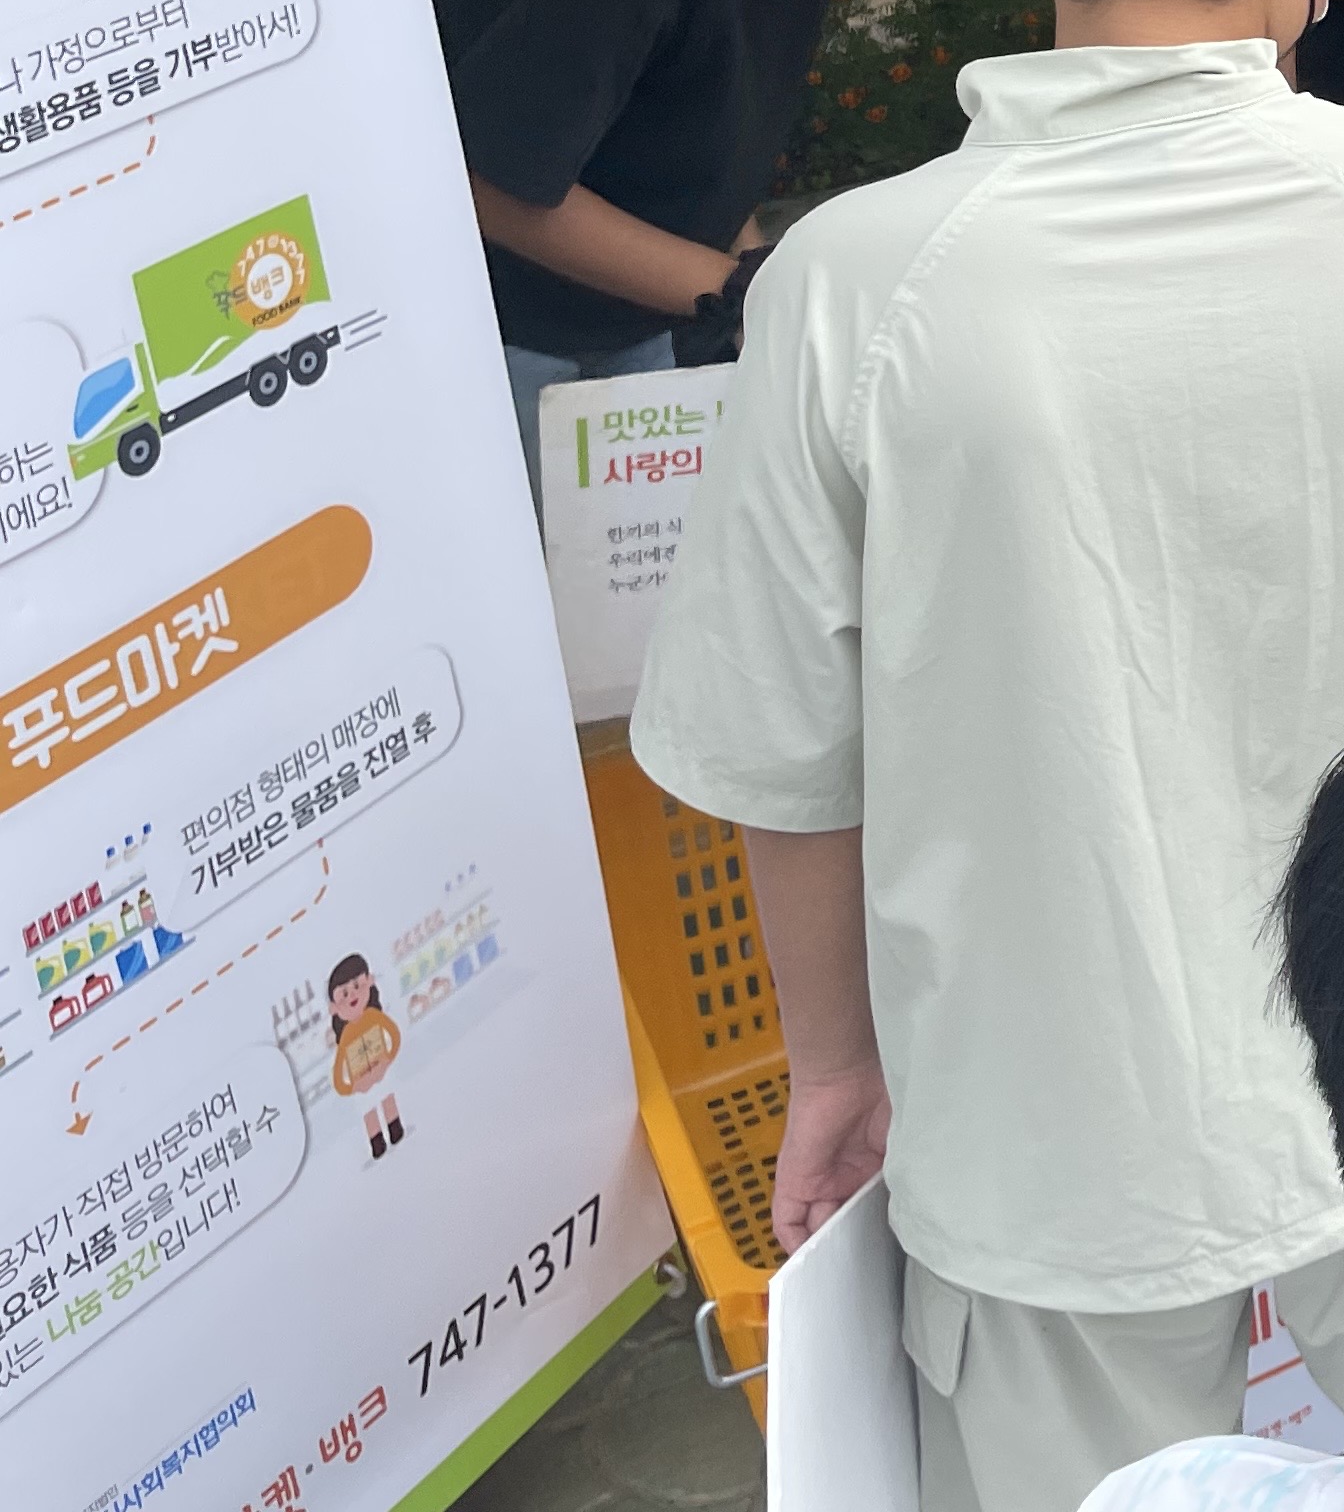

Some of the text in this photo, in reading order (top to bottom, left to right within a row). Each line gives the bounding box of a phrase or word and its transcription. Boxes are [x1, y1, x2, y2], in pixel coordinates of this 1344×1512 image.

[0, 3, 301, 154] 생활용품 등을 기부받아서!
[603, 403, 705, 444] 맛있는
[603, 445, 704, 485] 사랑의
[0, 475, 73, 544] 에요!
[2, 586, 239, 770] 푸드마켓
[180, 686, 402, 856] 편의점 형태의 매장에
[191, 711, 438, 895] 기부받은 물품을 진열 후
[0, 1104, 281, 1340] 요한 식품 등을 선택할 수
[76, 1160, 134, 1218] 직접
[135, 1083, 238, 1181] 방문하여
[46, 1288, 103, 1344] 나눔
[106, 1178, 242, 1301] 공간입니다!
[408, 1194, 601, 1397] 747-1377
[112, 1387, 257, 1512] 사회복지협의회
